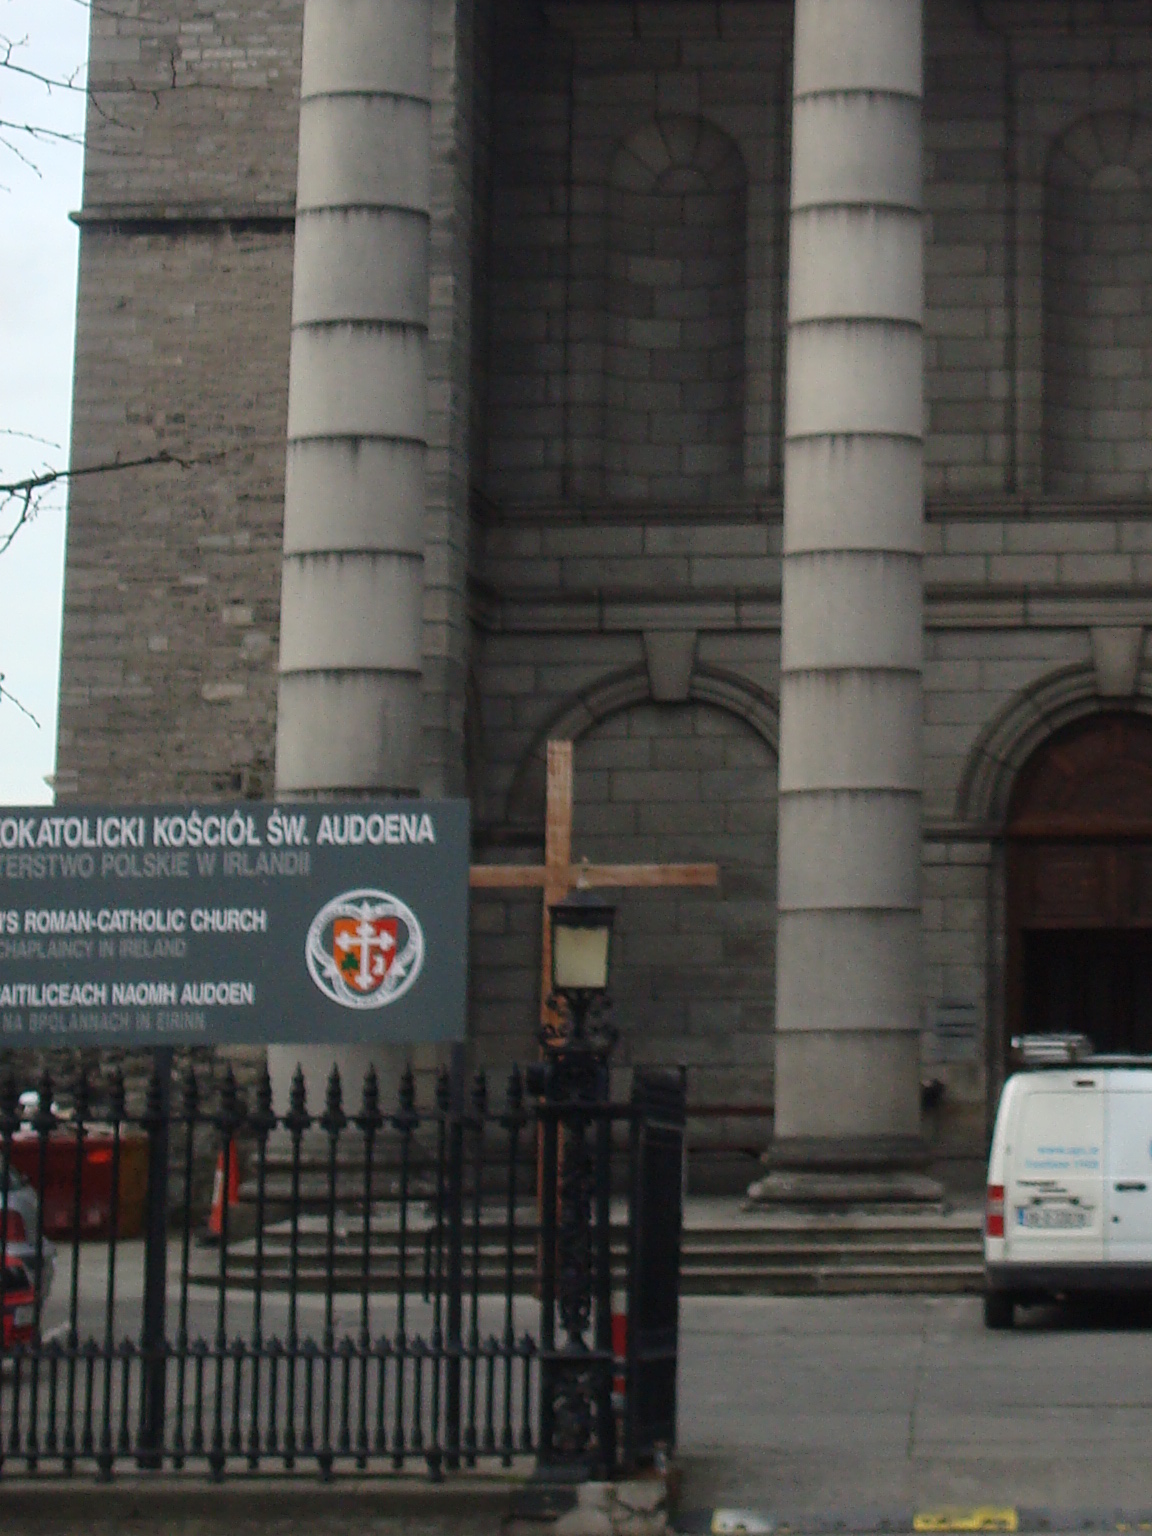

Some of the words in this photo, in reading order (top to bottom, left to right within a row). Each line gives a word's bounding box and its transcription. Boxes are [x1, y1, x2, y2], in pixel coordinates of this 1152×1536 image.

[0, 816, 145, 849] OKATOLICKI
[153, 809, 262, 847] KOŚCIÓŁ
[266, 808, 309, 846] ŚW.
[316, 813, 436, 845] AUDOENA
[102, 852, 190, 878] POLSKIE
[197, 852, 216, 877] W
[223, 850, 311, 876] IRLANDII
[24, 908, 187, 934] ROMAN-CATHOLIC
[190, 908, 267, 932] CHURCH
[119, 938, 187, 958] IRELAND
[0, 983, 108, 1007] AITILICEACH
[112, 983, 177, 1005] NAOMH
[180, 982, 255, 1005] AUDOEN
